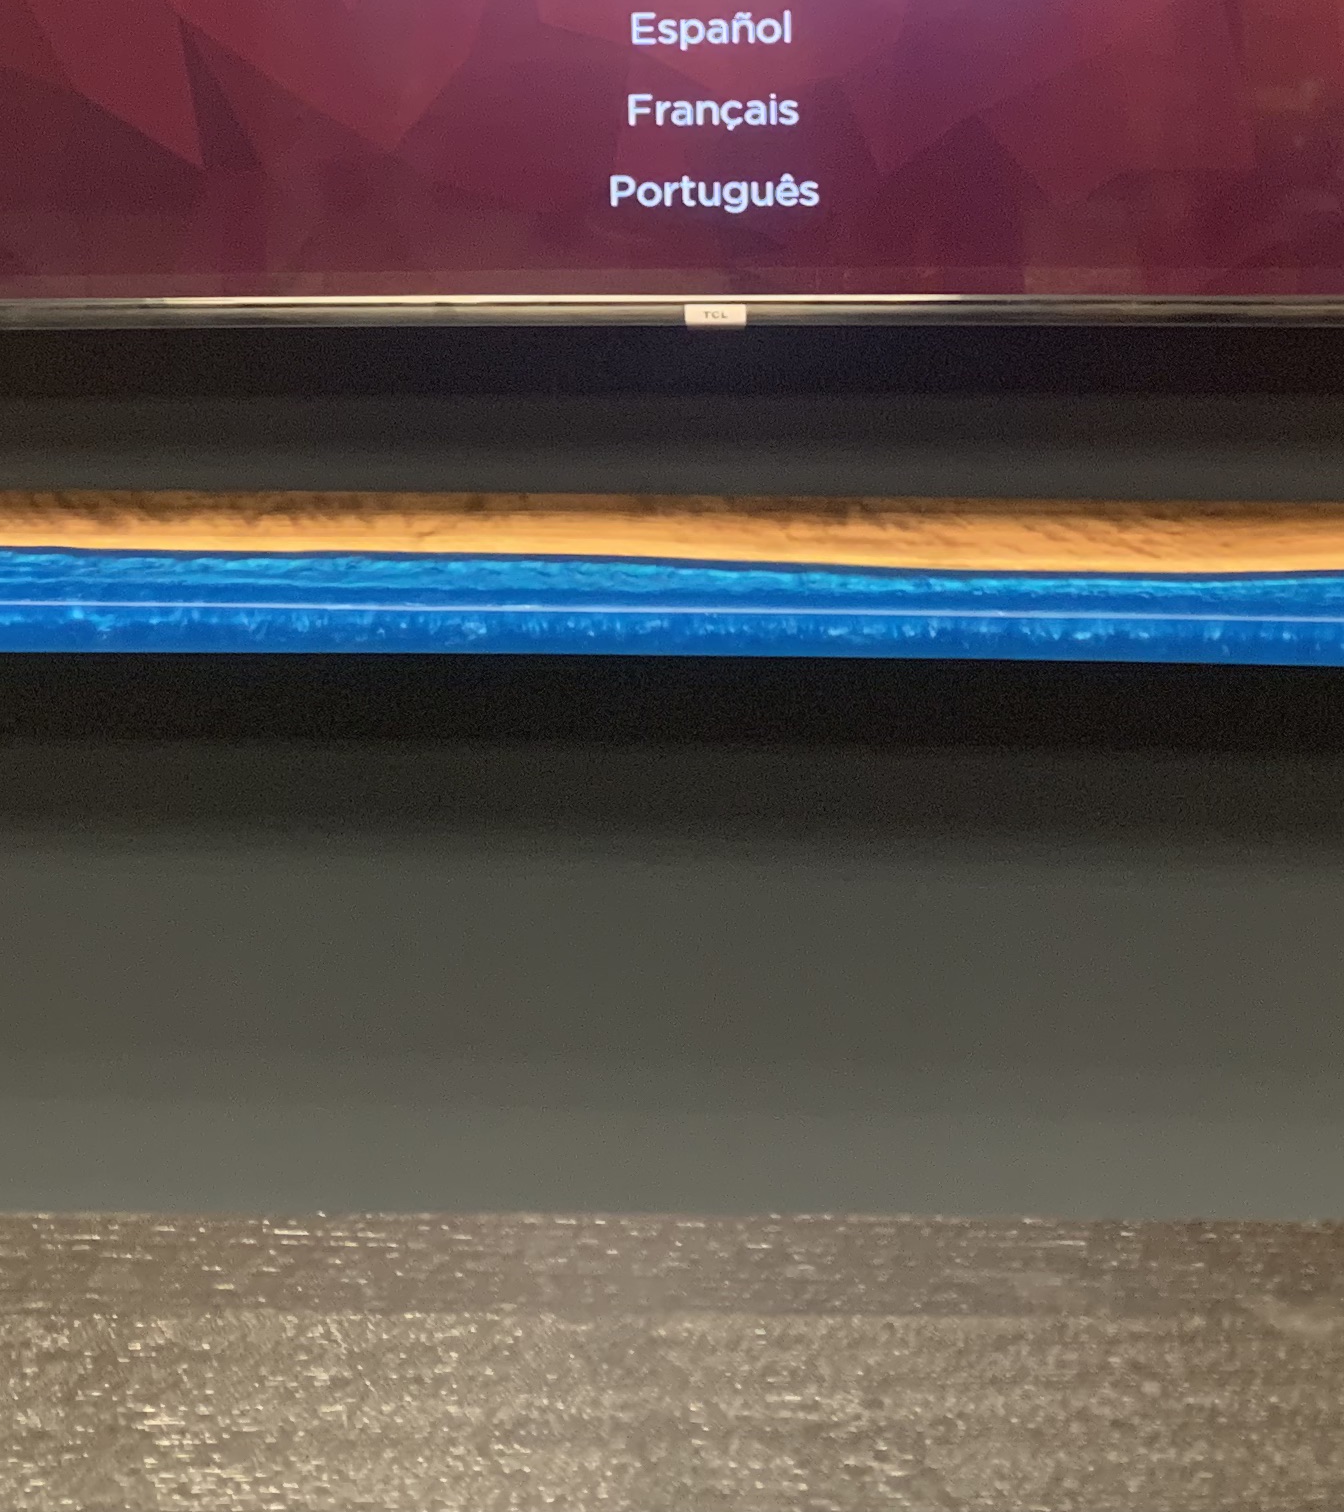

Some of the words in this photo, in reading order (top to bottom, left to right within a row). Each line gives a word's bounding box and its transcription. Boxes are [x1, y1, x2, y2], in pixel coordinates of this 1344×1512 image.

[630, 9, 793, 52] Español
[626, 92, 801, 132] Français
[608, 172, 821, 215] Português
[703, 310, 728, 319] TCL
